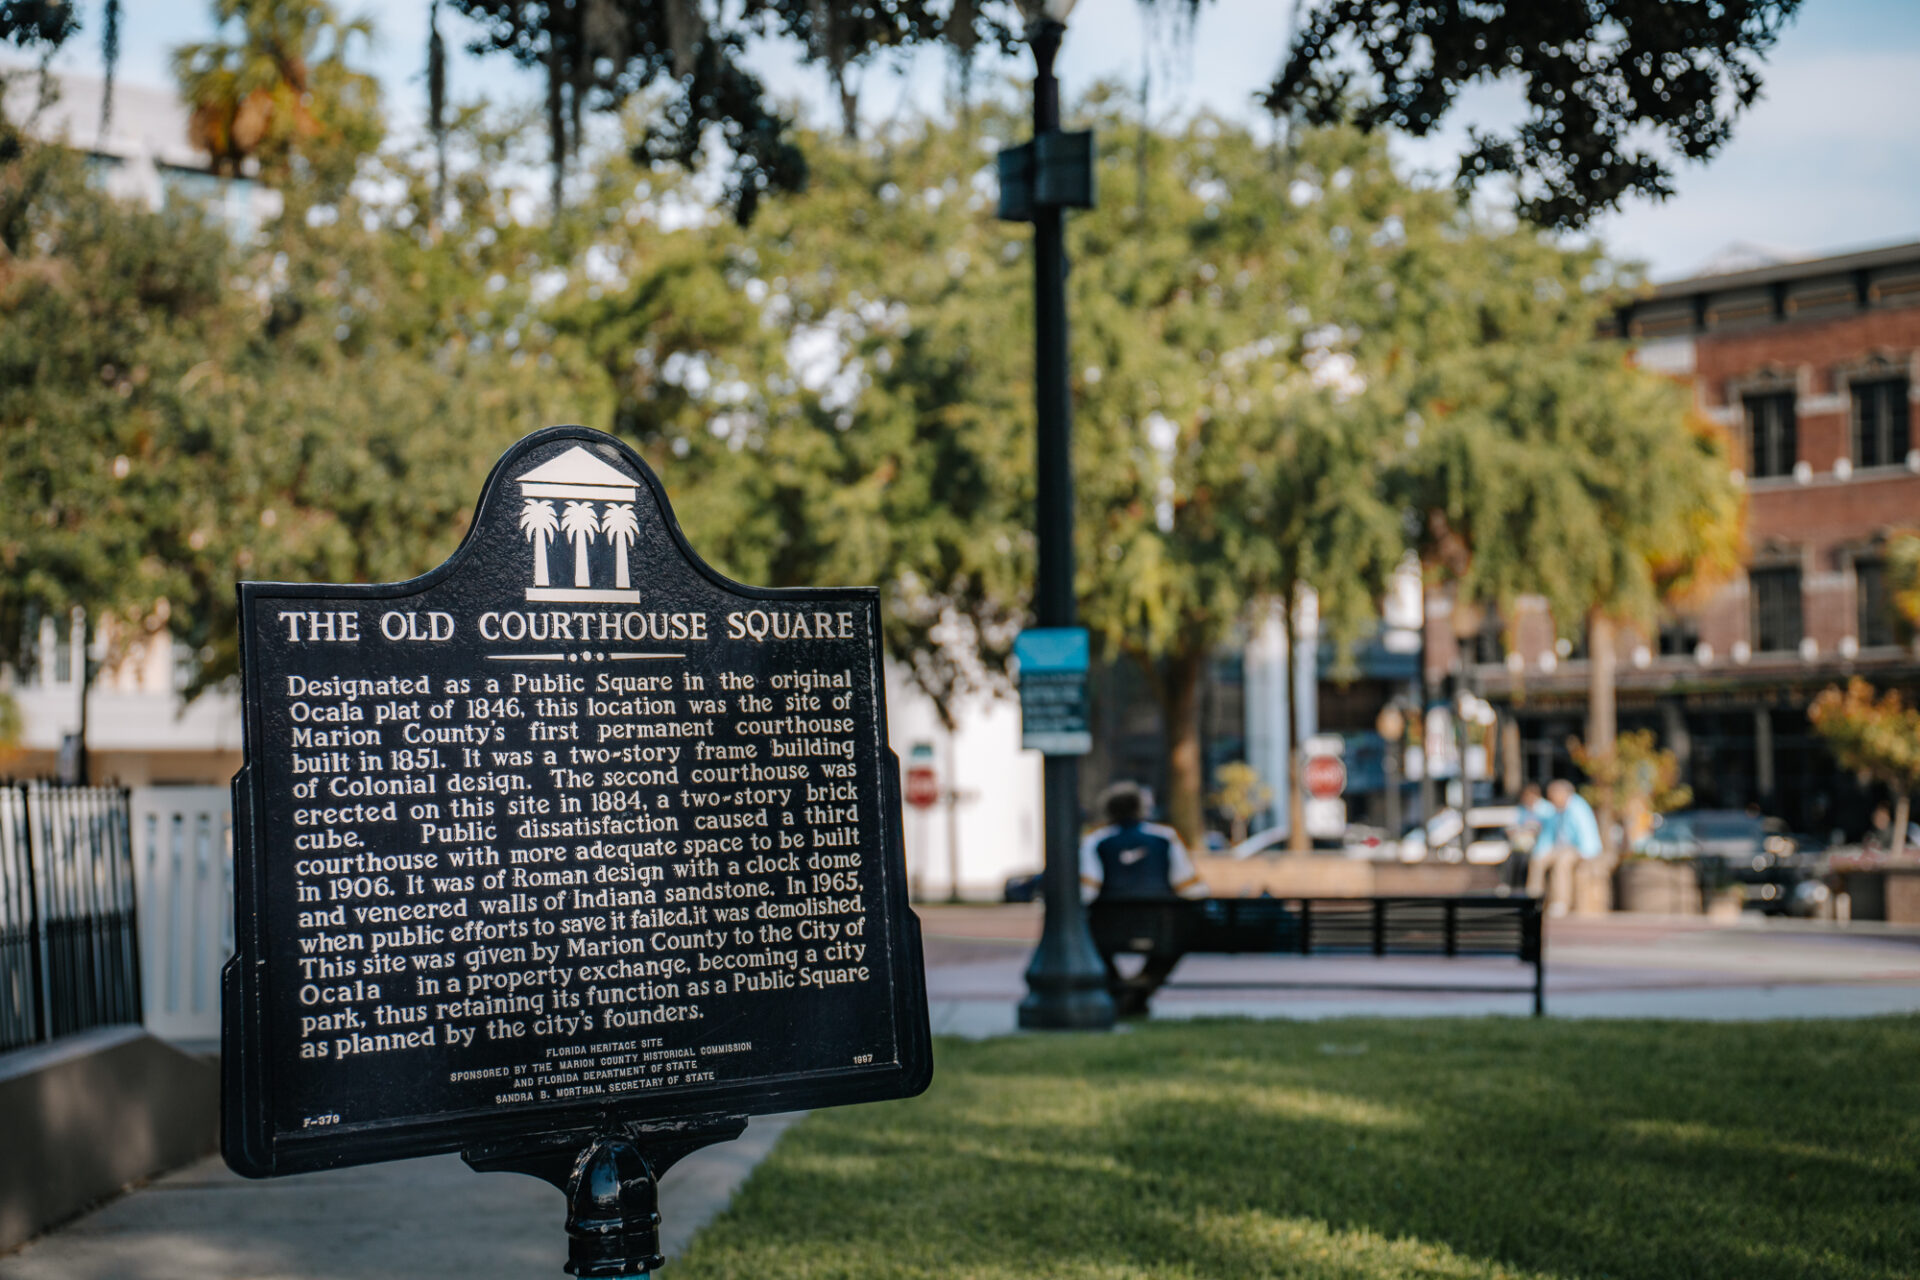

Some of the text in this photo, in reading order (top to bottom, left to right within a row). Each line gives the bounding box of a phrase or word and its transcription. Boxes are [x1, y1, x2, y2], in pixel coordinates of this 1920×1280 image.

[277, 609, 854, 643] THE OLD COURTHOUSE SQUARE
[286, 668, 852, 702] Designated as a Public Square in the original
[288, 690, 853, 725] Ocala plat of 1846, this location was the site of
[291, 715, 854, 748] Marion County's first permanent courthouse
[292, 737, 855, 774] built in 1851. It was a two-story frame building
[292, 762, 857, 799] of Colonial design. The second courthouse was
[293, 781, 858, 826] erected on this site in 1884, a two-story brick
[295, 804, 859, 851] cube. Public dissatisfaction caused a third
[294, 826, 860, 876] courthouse with more adequate space to be built
[296, 852, 862, 902] in 1906. It was of Roman design with a clock dome
[299, 870, 864, 928] and veneered walls of Indiana sandstone. In 1965,
[298, 932, 364, 954] when
[371, 924, 444, 954] public
[449, 919, 529, 942] efforts
[532, 917, 555, 936] to
[559, 915, 607, 934] save
[610, 910, 626, 931] it
[713, 907, 750, 923] was
[755, 894, 866, 919] demolished.
[299, 916, 866, 980] This site was given by Marion County to the City of
[300, 941, 866, 1005] Ocala in a property exchange, becoming a city
[302, 966, 870, 1038] park, thus retaining its function as a Public Square
[301, 1004, 704, 1060] as planned by the city's founders.
[546, 1038, 663, 1058] FLORIDA HERITAGE SITE
[450, 1041, 752, 1082] SPONSORED BY THE MARION COUNTY HISTORICAL COMMISSION
[514, 1060, 698, 1089] AND FLORIDA DEPARTMENT OF STATE
[495, 1091, 534, 1104] SANDRA
[540, 1090, 550, 1100] B.
[608, 1077, 664, 1093] SECRETARY
[667, 1075, 679, 1085] OF
[685, 1071, 715, 1083] STATE
